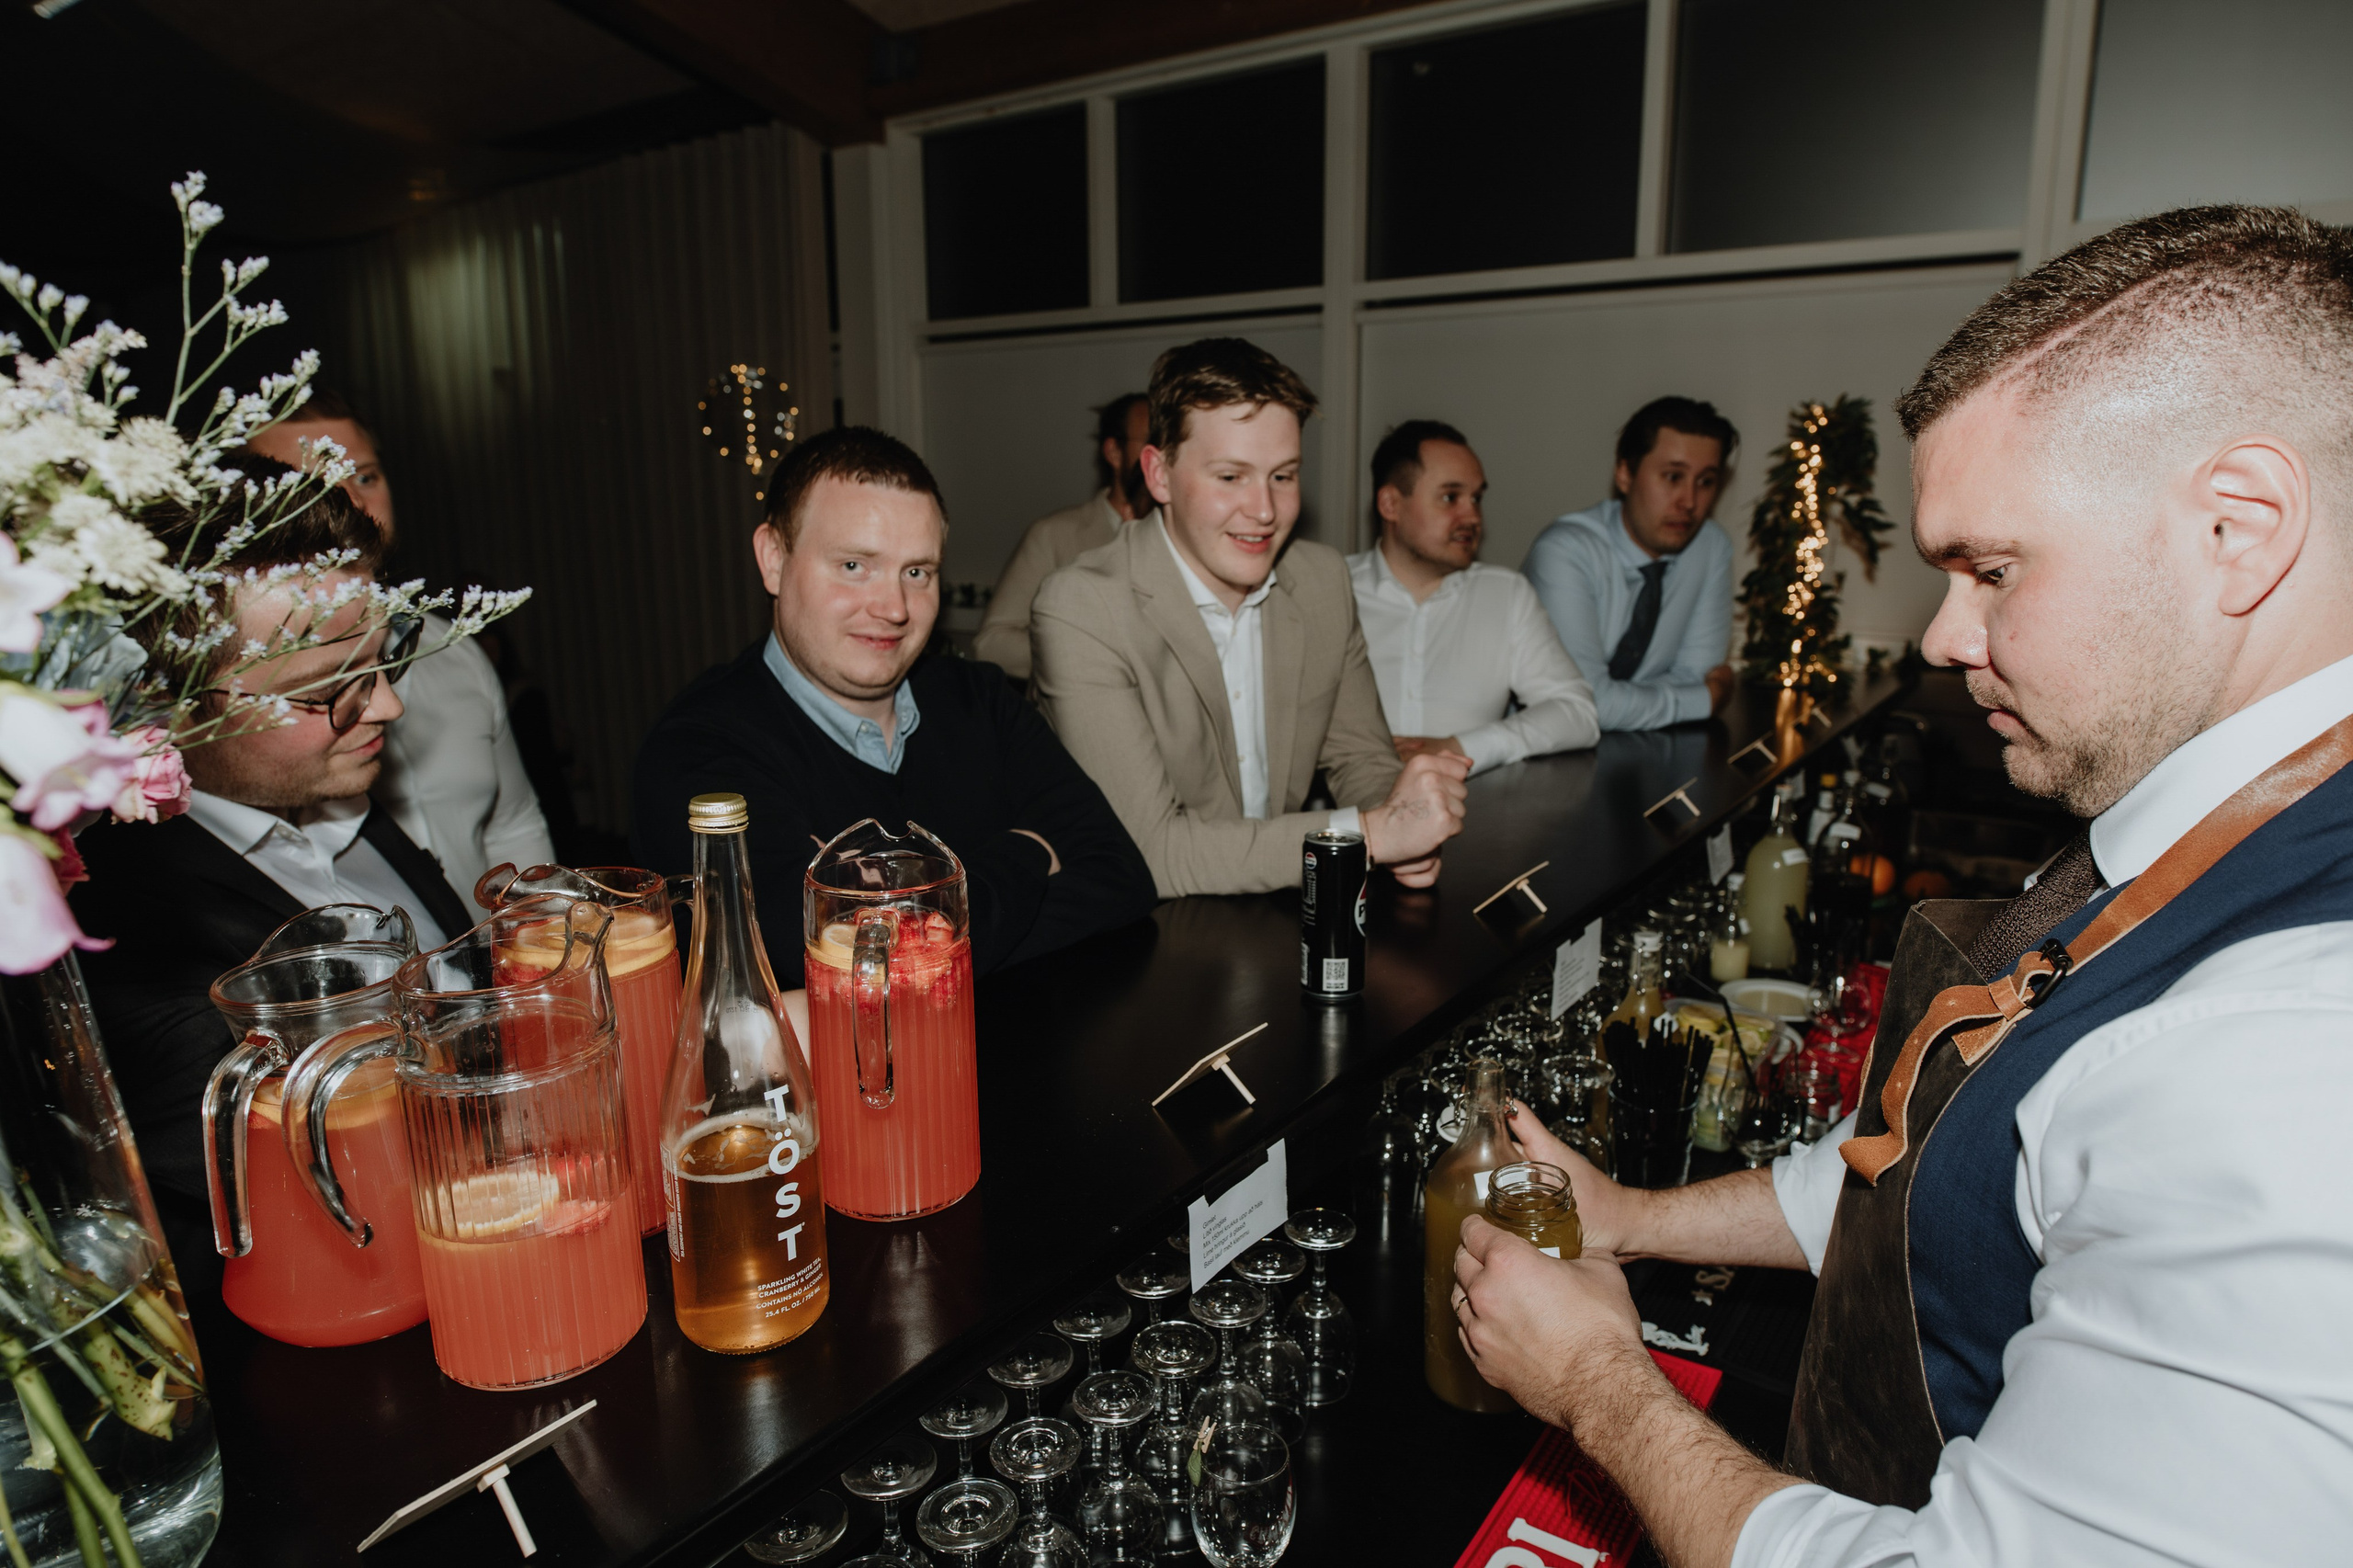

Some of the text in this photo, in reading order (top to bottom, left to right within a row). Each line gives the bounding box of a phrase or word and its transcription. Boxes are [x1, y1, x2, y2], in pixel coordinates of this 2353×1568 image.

[764, 1085, 803, 1262] TÖST
[757, 1274, 796, 1291] SPARKLING
[796, 1263, 813, 1278] WHITE
[758, 1278, 800, 1299] CRANBERRY
[804, 1263, 822, 1279] GINGER
[756, 1293, 792, 1310] CONTAINS
[765, 1309, 780, 1318] 25.4
[780, 1305, 790, 1313] FL.
[790, 1300, 801, 1309] OZ.
[805, 1290, 814, 1301] 750
